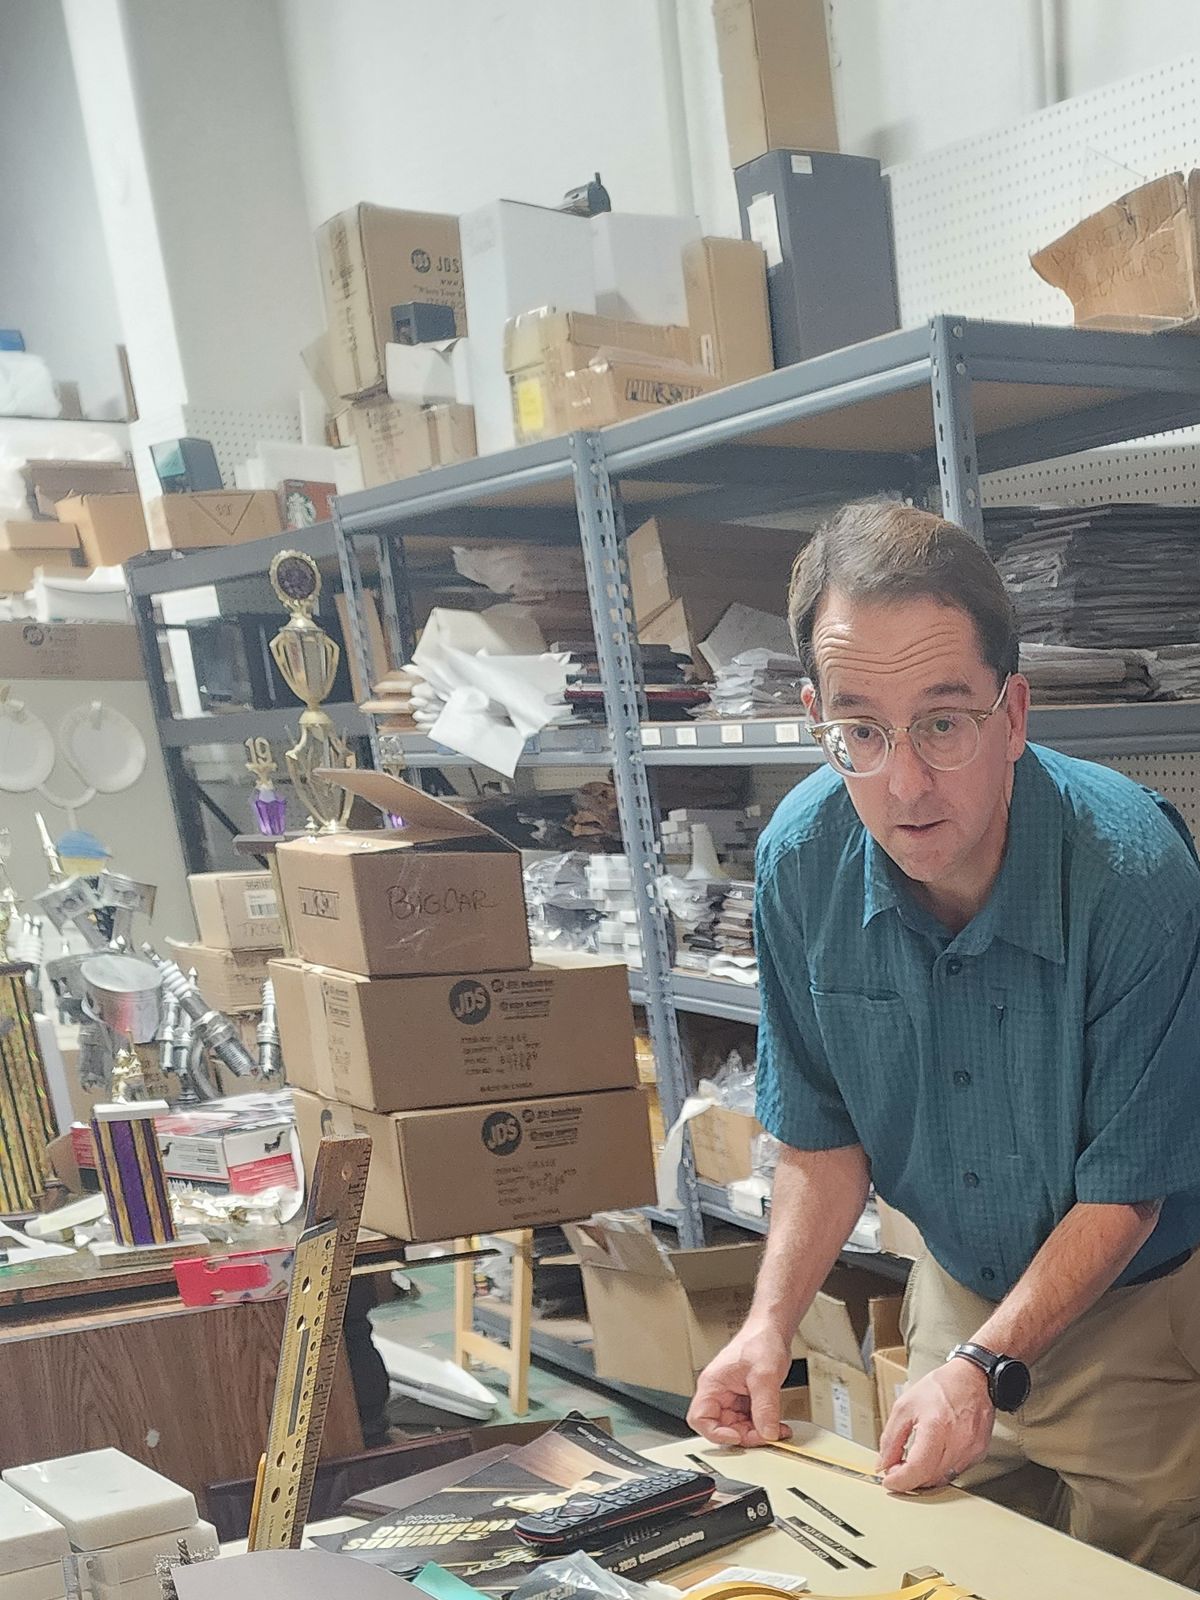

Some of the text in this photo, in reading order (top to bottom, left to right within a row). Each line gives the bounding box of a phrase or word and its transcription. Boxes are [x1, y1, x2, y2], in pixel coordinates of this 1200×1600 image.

[452, 986, 488, 1017] JDS
[485, 1117, 518, 1149] JDS
[619, 1531, 703, 1571] 2025 Components Catalog
